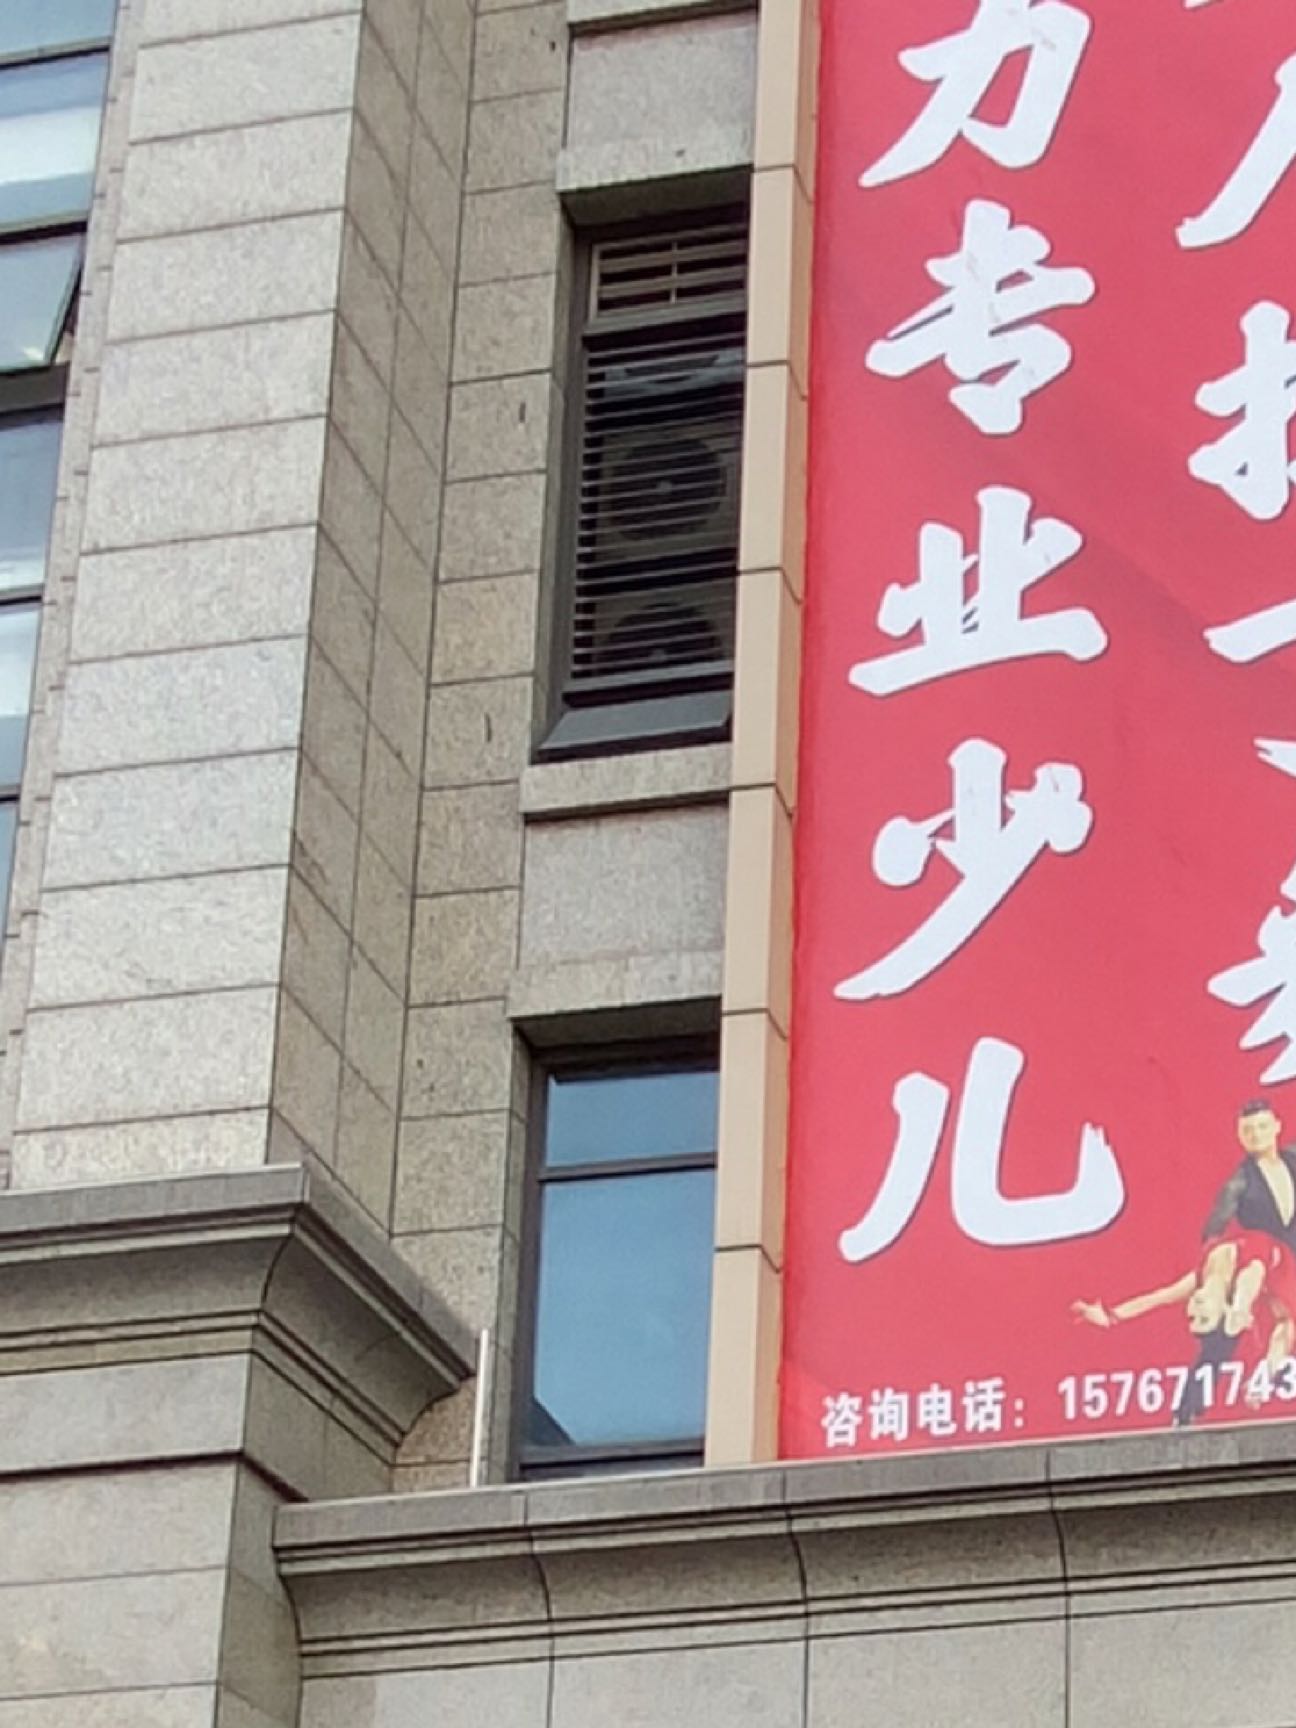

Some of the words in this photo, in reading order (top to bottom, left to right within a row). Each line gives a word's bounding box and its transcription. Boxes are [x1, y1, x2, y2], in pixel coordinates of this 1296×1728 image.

[834, 0, 1126, 1264] 力专业少儿
